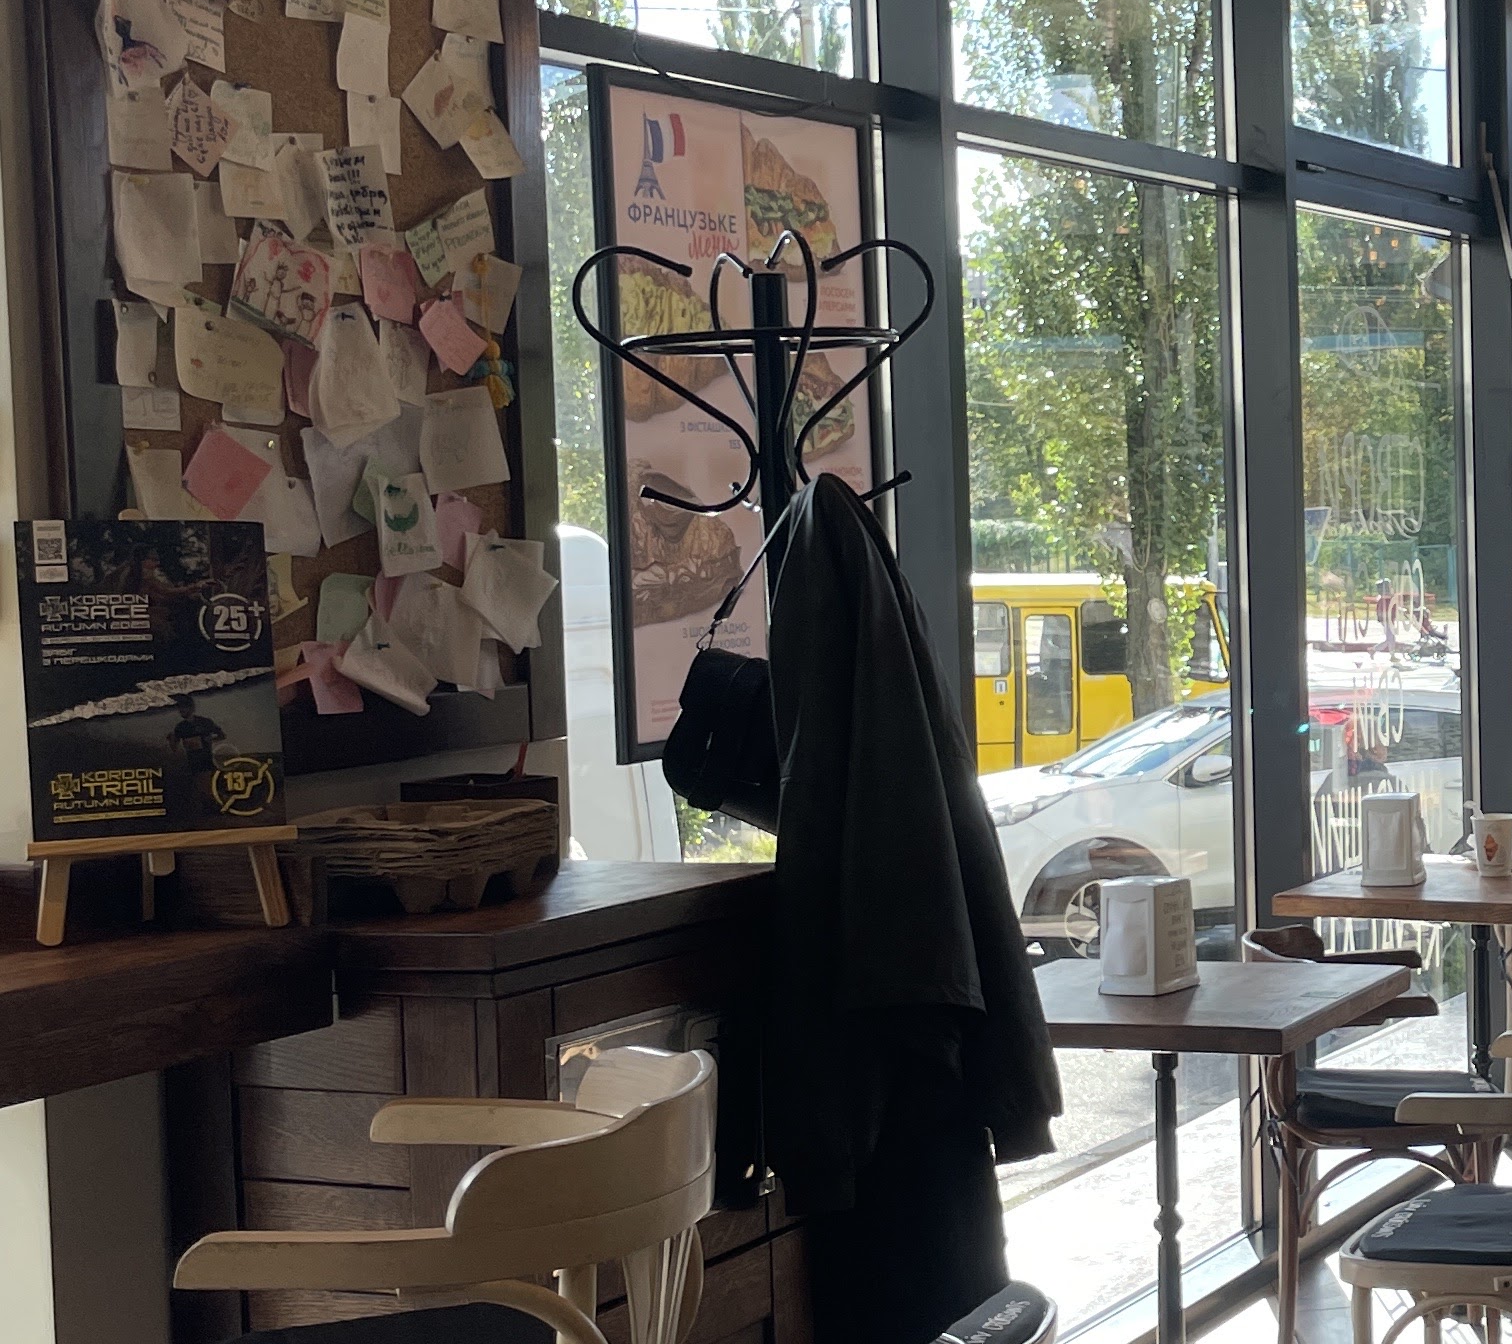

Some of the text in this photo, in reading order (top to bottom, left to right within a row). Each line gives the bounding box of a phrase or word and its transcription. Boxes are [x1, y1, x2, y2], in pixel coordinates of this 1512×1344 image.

[628, 203, 737, 234] ФРАНЦУЗЬКЕ
[69, 594, 149, 605] KORDON
[70, 605, 150, 620] RACE
[41, 622, 107, 632] AUTUMN
[82, 767, 163, 781] KORDON
[82, 781, 164, 797] TRAIL
[53, 798, 119, 810] AUTUMN
